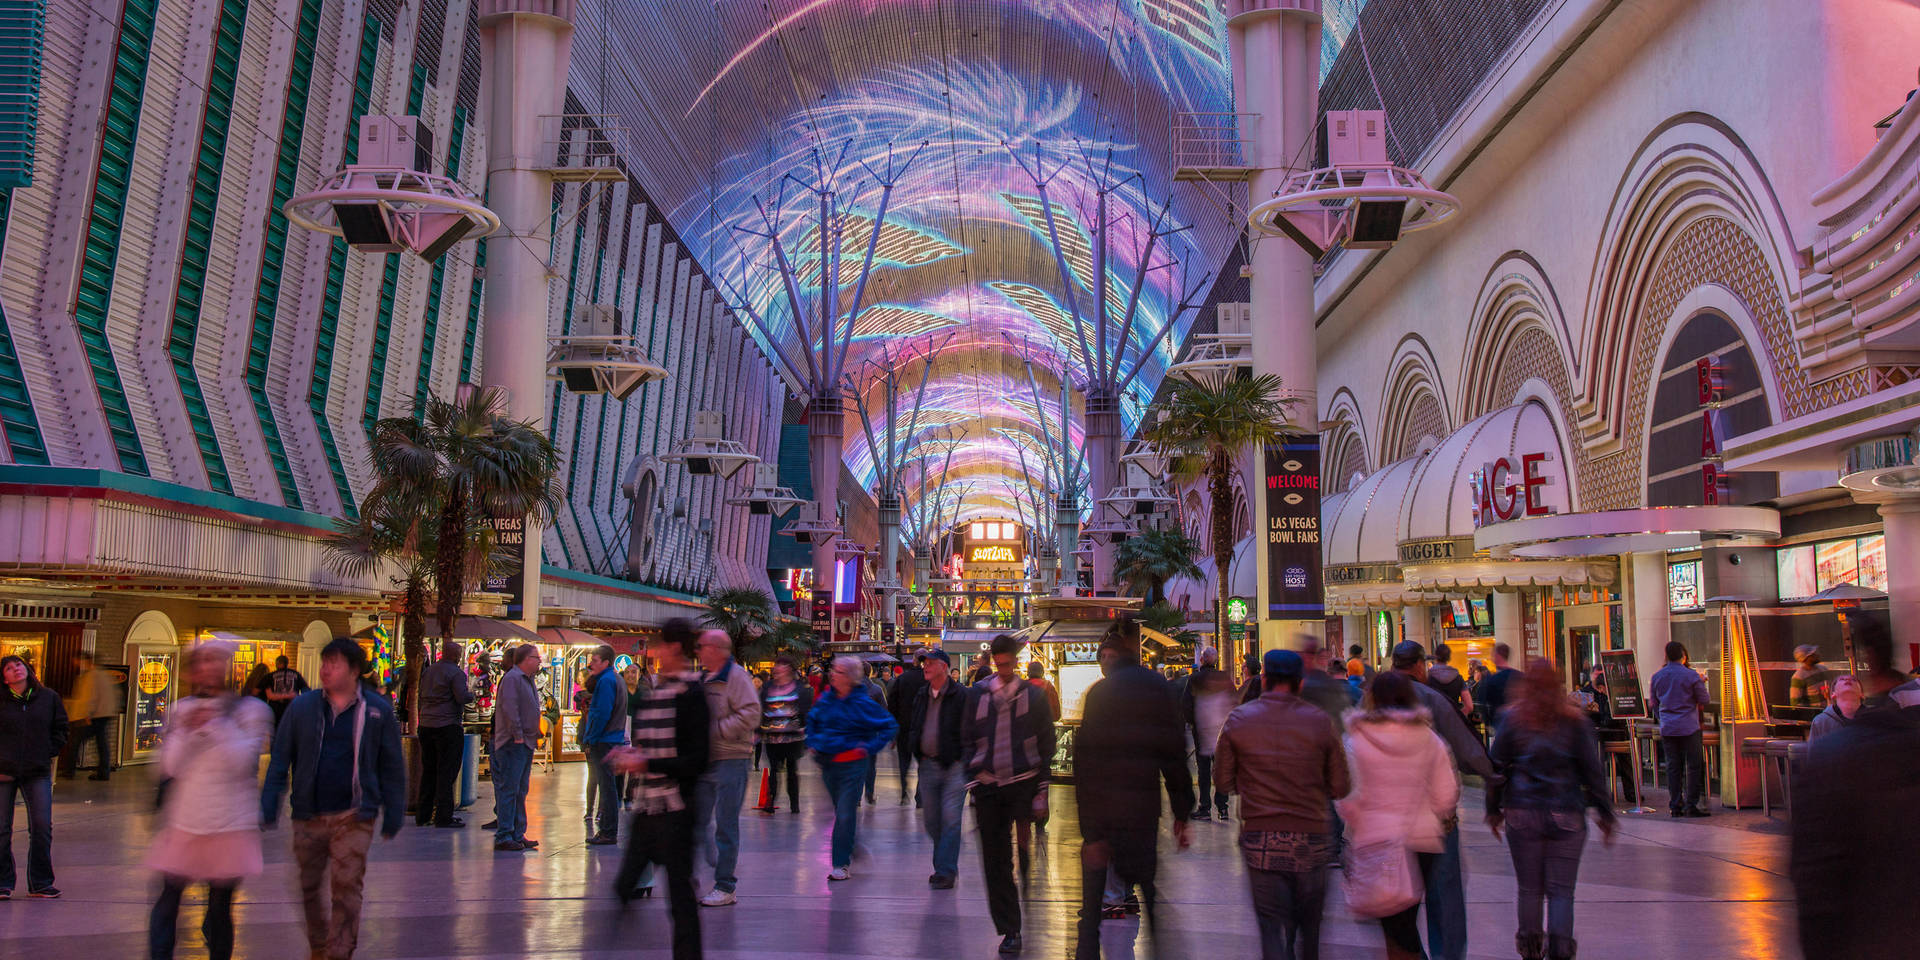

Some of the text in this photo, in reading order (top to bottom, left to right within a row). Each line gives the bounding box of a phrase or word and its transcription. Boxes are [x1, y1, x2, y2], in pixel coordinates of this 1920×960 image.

[1267, 474, 1319, 489] WELCOME
[494, 518, 522, 530] VEGAS
[1271, 517, 1317, 529] LAS VEGAS
[501, 532, 523, 544] FANS
[1270, 531, 1319, 543] BOWL FANS
[1401, 542, 1454, 561] NUGGET
